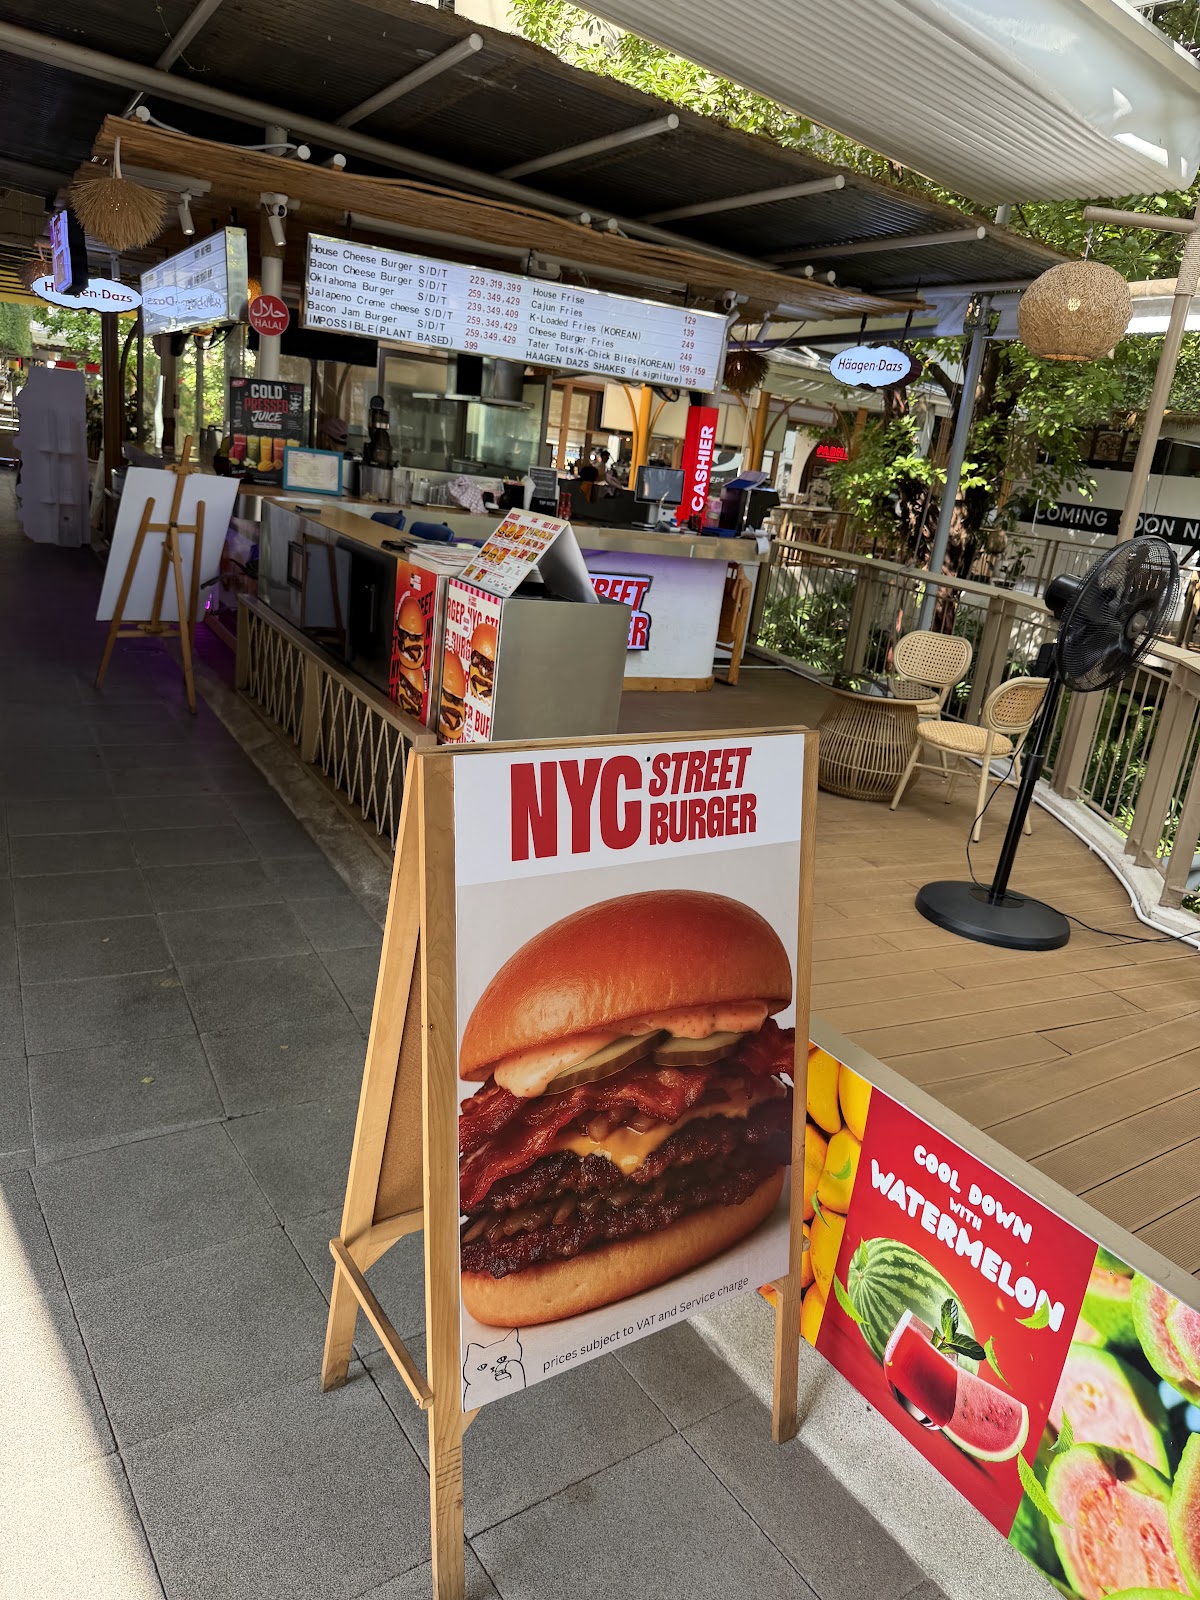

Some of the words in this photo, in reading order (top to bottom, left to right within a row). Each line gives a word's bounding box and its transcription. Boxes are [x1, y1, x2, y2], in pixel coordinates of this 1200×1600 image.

[311, 244, 338, 257] House
[343, 250, 376, 265] Cheese
[381, 257, 413, 271] Burger
[418, 265, 448, 278] S/D/T
[310, 258, 338, 271] Bacon
[343, 265, 376, 278] Cheese
[380, 272, 413, 286] Burger
[418, 279, 447, 292] S/D/T
[309, 272, 357, 289] Oklahoma
[362, 281, 394, 296] Burger
[418, 292, 447, 305] S/D/T
[533, 287, 557, 299] House
[561, 292, 585, 304] Frise
[251, 298, 286, 318] حلال
[307, 300, 336, 313] Bacon
[342, 307, 360, 317] Jam
[365, 310, 397, 324] Burger
[417, 320, 445, 331] S/D/T
[308, 287, 352, 302] Jalapeno
[357, 295, 386, 308] Creme
[390, 302, 420, 314] cheese
[424, 308, 453, 320] S/D/T
[531, 300, 555, 312] Cajun
[560, 305, 583, 317] Fries
[254, 318, 283, 331] HALAL
[529, 312, 569, 327] K-Loaded
[572, 320, 596, 333] Fries
[601, 325, 641, 341] (KOREAN)
[683, 328, 695, 337] 139
[684, 316, 696, 325] 129
[418, 332, 453, 347] BASED)
[464, 340, 478, 350] 399
[528, 326, 557, 339] Cheese
[560, 331, 587, 344] Burger
[591, 337, 614, 348] Fries
[681, 341, 695, 350] 249
[526, 350, 562, 364] HAAGEN
[566, 357, 589, 369] DAZS
[593, 361, 626, 375] SHAKES
[643, 370, 683, 384] signiture)
[528, 338, 549, 350] Tater
[614, 353, 675, 371] Bites(KOREAN)
[680, 352, 693, 361] 249
[250, 384, 283, 400] COLD
[685, 377, 697, 386] 195
[243, 397, 289, 414] PRESSED
[251, 410, 283, 422] JUICE
[691, 425, 714, 512] CASHIER
[1118, 514, 1175, 536] OON
[648, 747, 753, 797] STREET
[510, 754, 643, 862] NYC
[649, 793, 758, 846] BURGER
[913, 1144, 961, 1194] COOL
[968, 1183, 1033, 1245] DOWN
[949, 1196, 983, 1232] WITH
[871, 1158, 1065, 1333] WATERMELON
[543, 1349, 578, 1374] prices
[580, 1330, 621, 1355] subject
[623, 1326, 635, 1337] to
[637, 1315, 657, 1331] VAT
[658, 1307, 678, 1322] and
[679, 1290, 716, 1313] Service
[717, 1276, 750, 1298] charge
